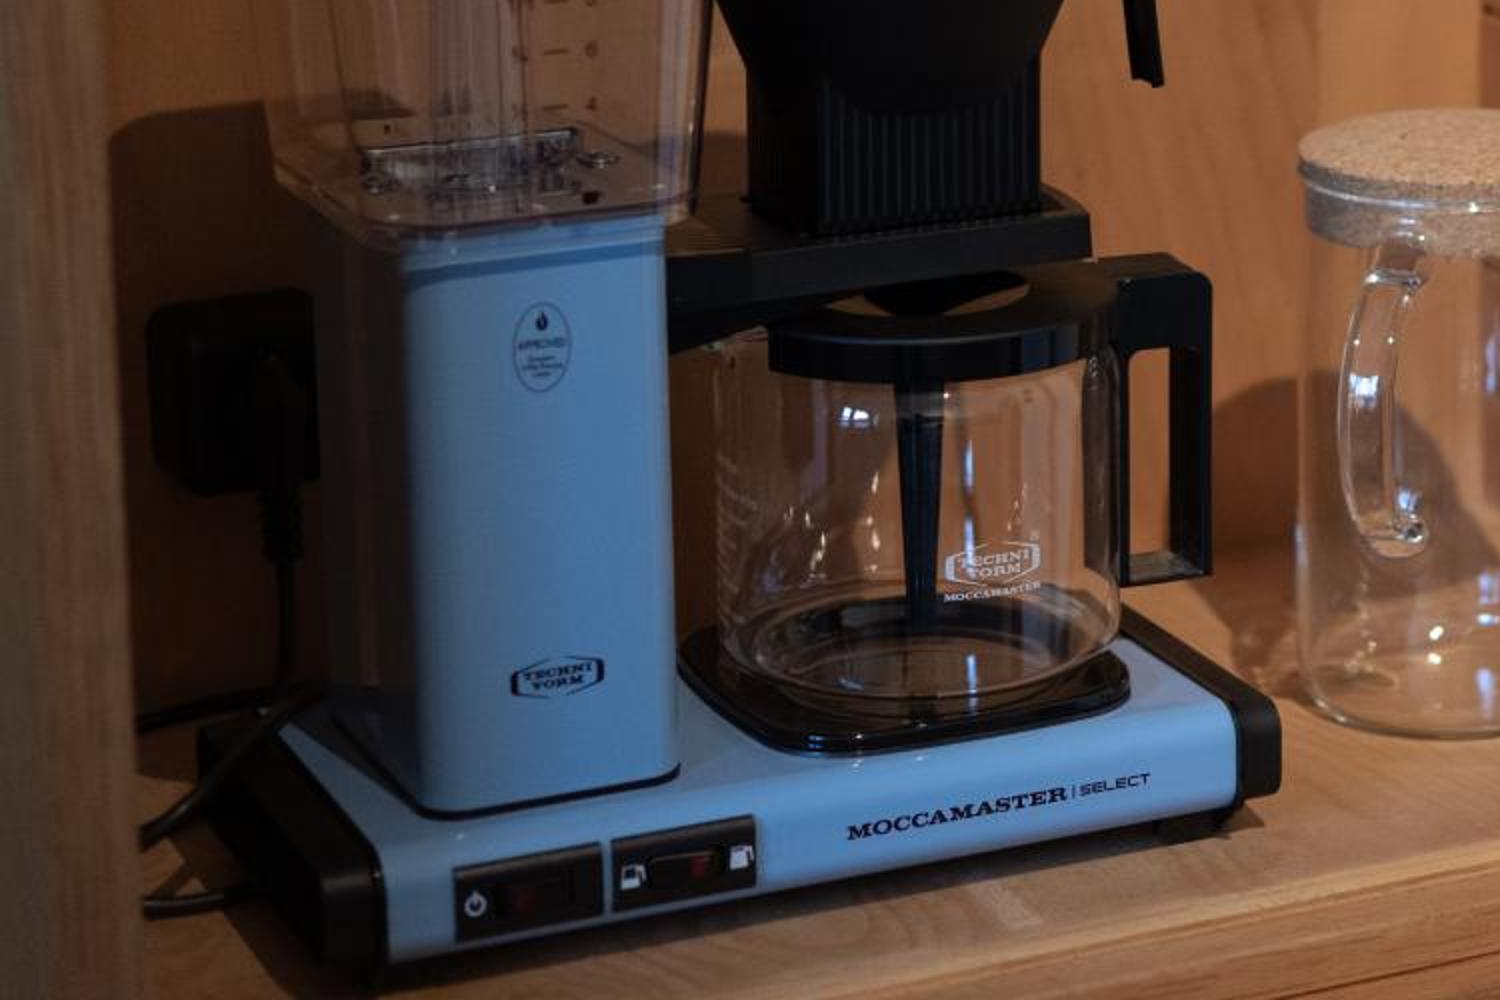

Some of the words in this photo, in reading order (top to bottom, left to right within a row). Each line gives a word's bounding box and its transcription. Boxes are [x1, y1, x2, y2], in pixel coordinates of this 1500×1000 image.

[523, 661, 593, 680] TECHNI
[847, 786, 1068, 841] MOCCAMASTER
[1079, 772, 1151, 799] SELECT
